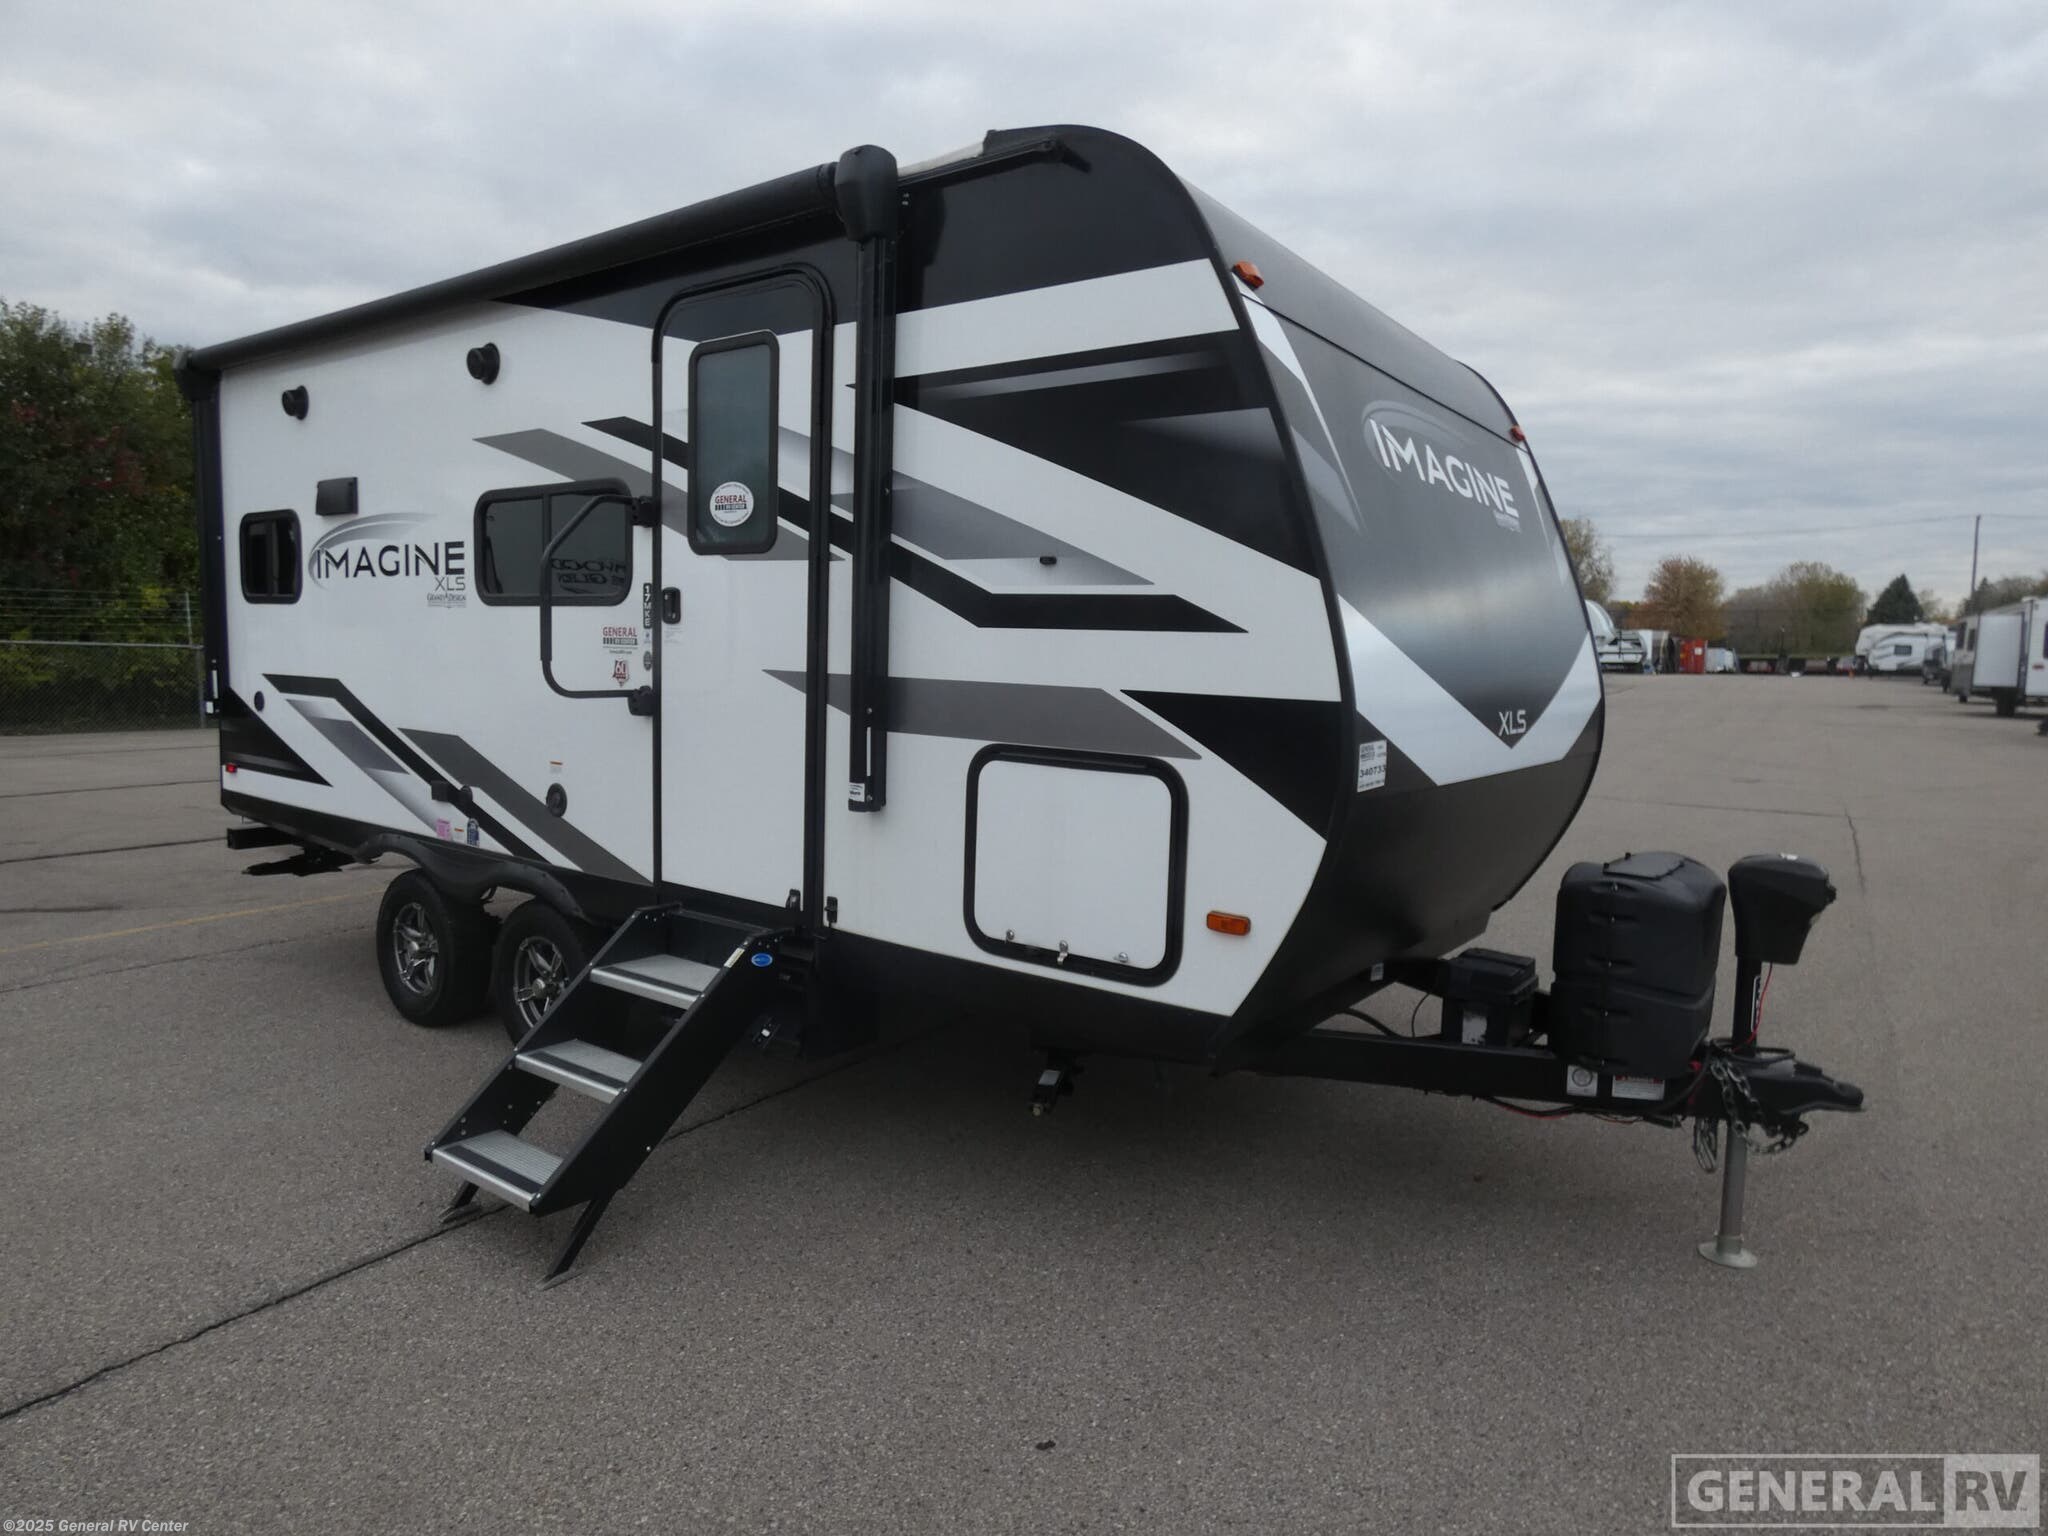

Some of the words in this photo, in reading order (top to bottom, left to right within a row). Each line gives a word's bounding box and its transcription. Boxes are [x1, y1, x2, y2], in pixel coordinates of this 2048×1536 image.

[1369, 418, 1520, 519] IMAGINE
[714, 494, 747, 504] GENERAL
[316, 541, 466, 579] IMAGINE
[434, 576, 466, 591] XLS
[602, 626, 638, 638] GENERAL
[1498, 709, 1527, 737] XLS
